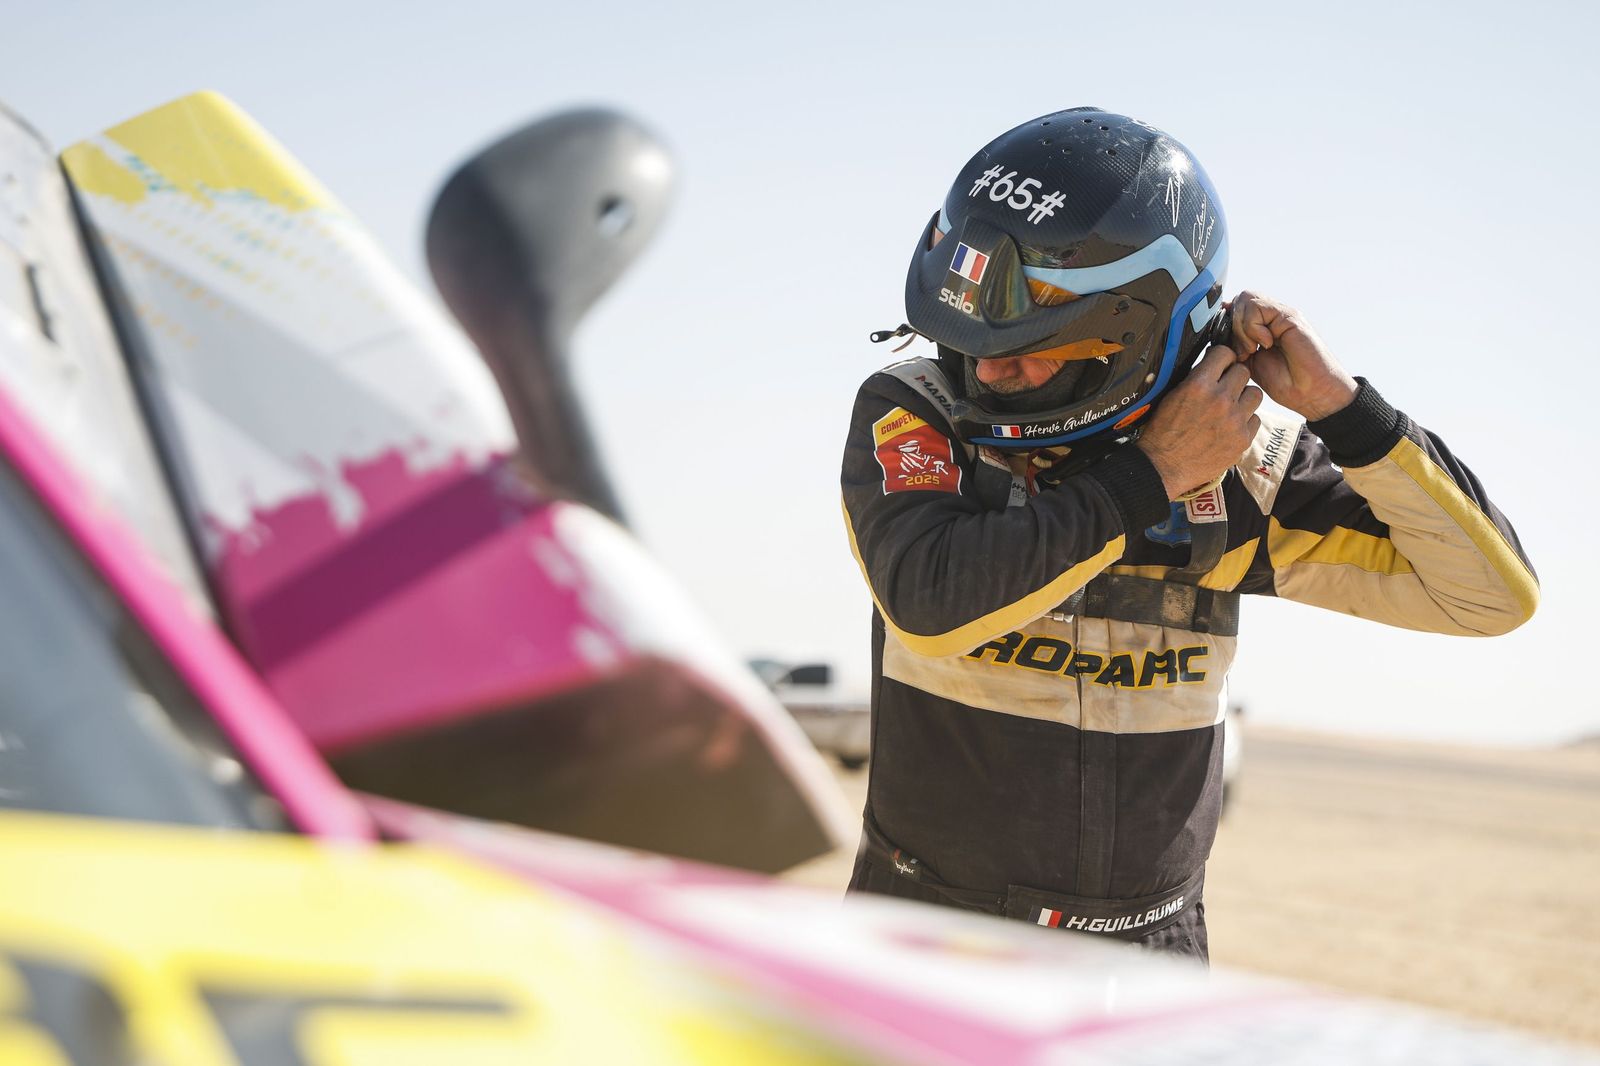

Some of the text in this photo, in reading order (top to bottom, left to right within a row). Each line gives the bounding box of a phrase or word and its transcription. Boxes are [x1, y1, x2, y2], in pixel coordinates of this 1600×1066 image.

[968, 164, 1067, 225] #65#
[938, 287, 974, 315] Stilo
[1024, 422, 1062, 438] Hervé
[1063, 404, 1118, 431] Guillaume
[1257, 427, 1286, 477] MARINA
[905, 474, 940, 486] 2025
[1066, 896, 1184, 932] H.GUILLAUME
